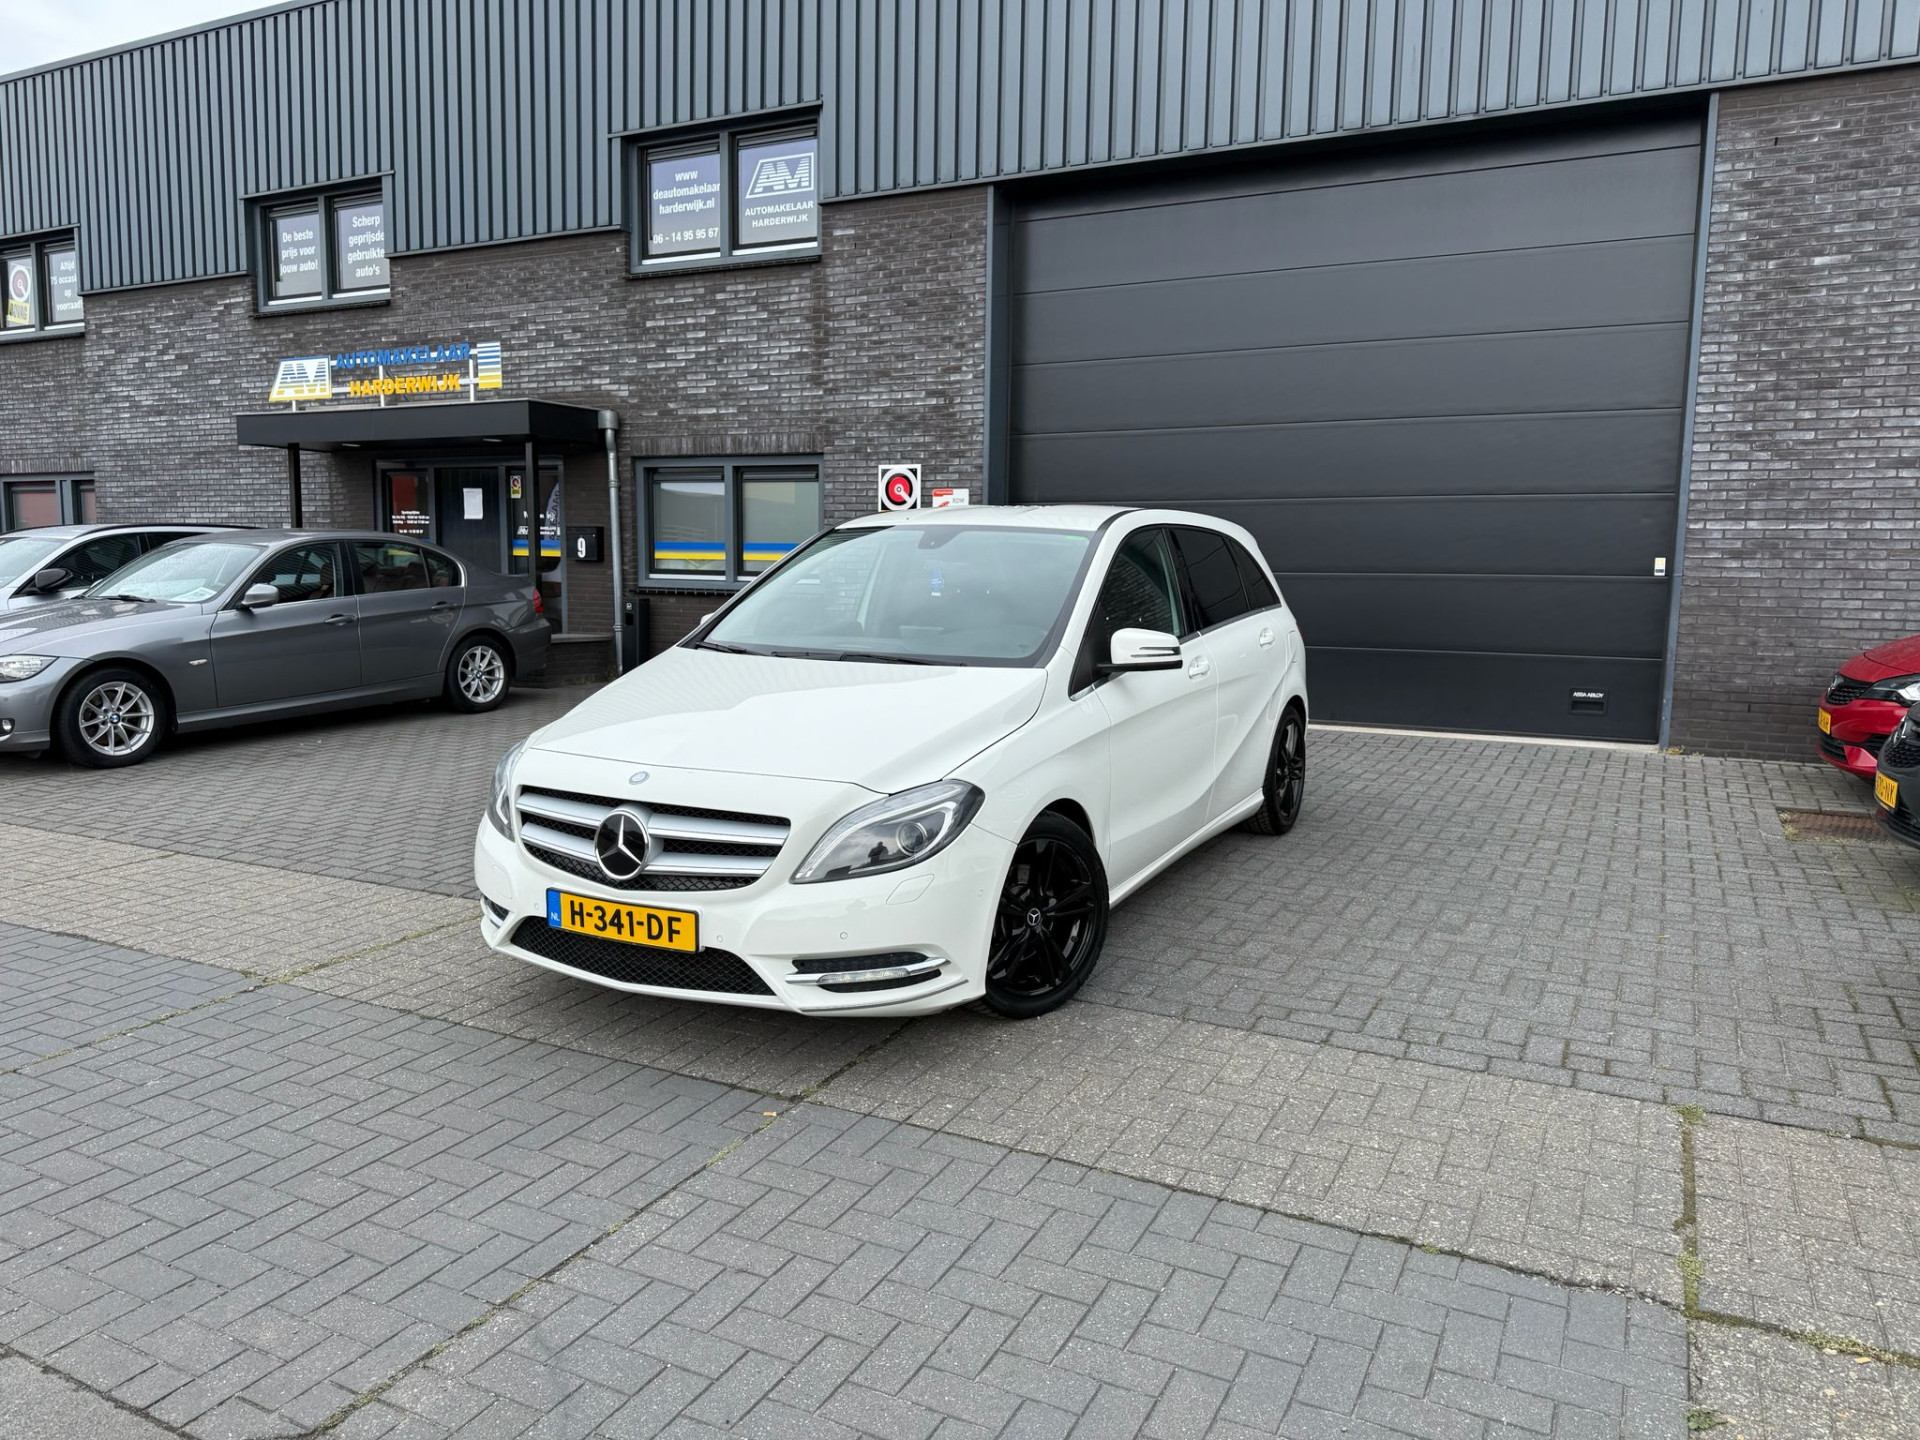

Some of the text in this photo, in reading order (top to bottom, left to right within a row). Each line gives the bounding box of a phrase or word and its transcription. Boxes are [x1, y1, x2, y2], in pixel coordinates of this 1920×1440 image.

[675, 170, 698, 182] www
[753, 156, 810, 194] AM
[653, 182, 720, 200] deautomakelaar
[659, 197, 715, 215] harderwijk.nl
[745, 200, 814, 217] AUTOMAKELAAR
[352, 215, 380, 228] Scherp
[752, 213, 809, 228] HARDERWIJK
[282, 230, 313, 243] De beste
[348, 230, 384, 247] geprijsde
[653, 233, 663, 244] 06
[672, 231, 681, 242] 14
[683, 230, 694, 241] 95
[696, 229, 706, 240] 95
[708, 227, 719, 239] 67
[281, 246, 316, 260] prijs voor
[347, 247, 384, 264] gebruikte
[280, 260, 318, 276] jouw auto!
[355, 264, 380, 277] auto's
[333, 343, 471, 370] AUTOMAKELAAR
[350, 373, 462, 398] HARDERWIJK
[577, 537, 586, 558] 9
[550, 899, 682, 943] NL H-341-DF
